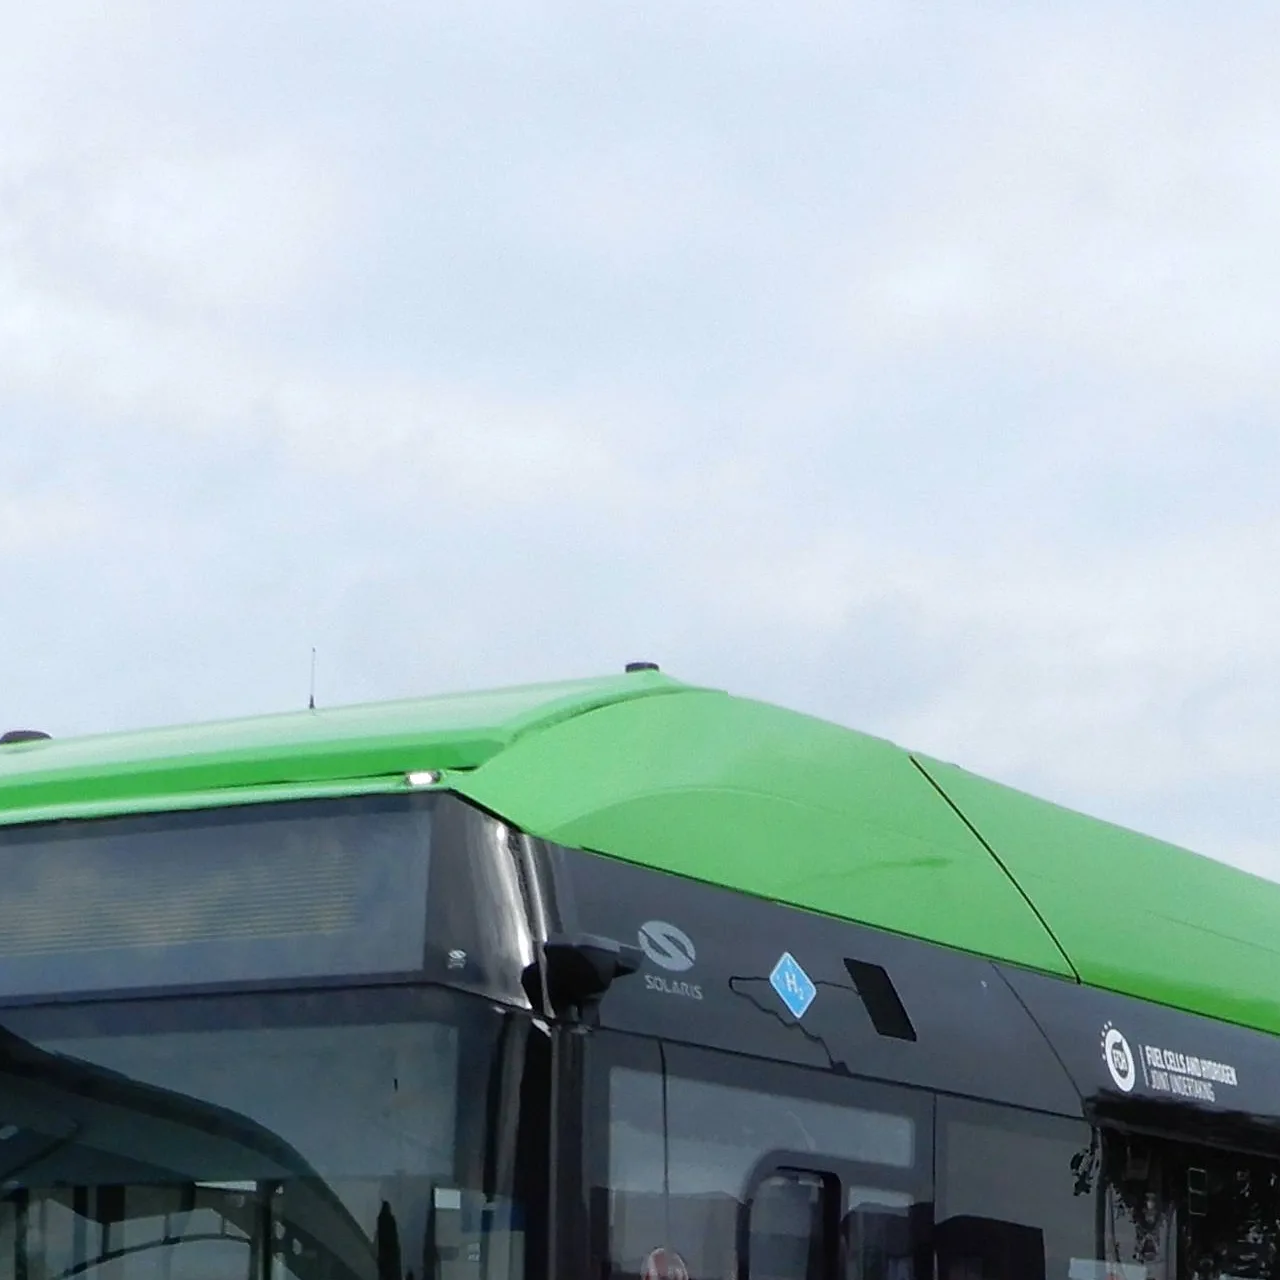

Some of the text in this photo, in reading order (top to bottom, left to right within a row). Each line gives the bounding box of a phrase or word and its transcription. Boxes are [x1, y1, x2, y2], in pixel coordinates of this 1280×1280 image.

[644, 974, 703, 1000] SOLARIS
[1145, 1045, 1165, 1069] FUEL
[1163, 1050, 1187, 1073] CELLS
